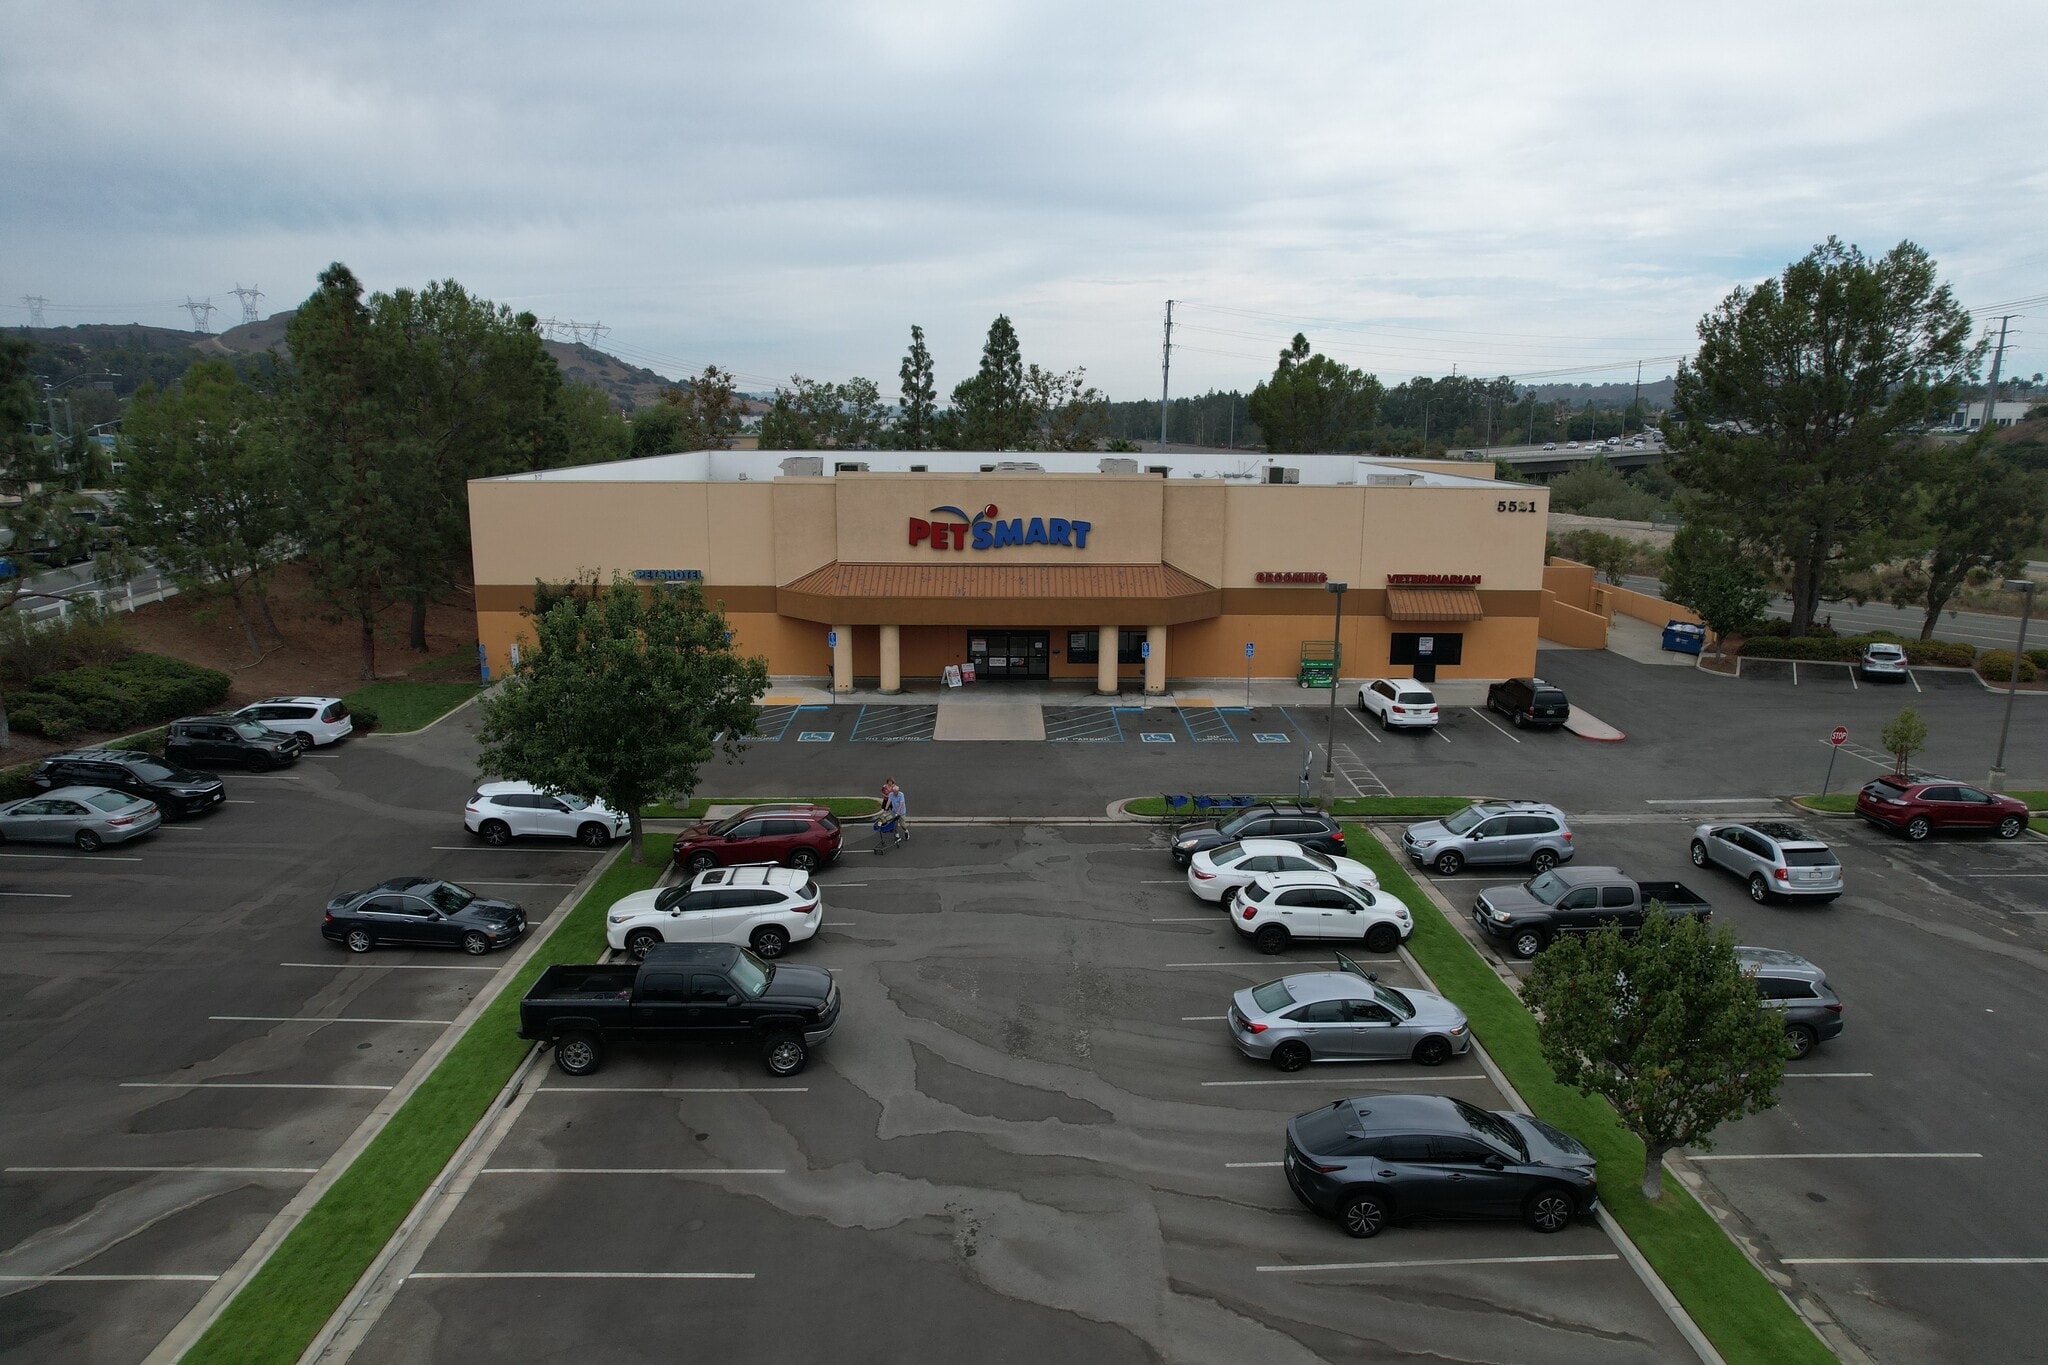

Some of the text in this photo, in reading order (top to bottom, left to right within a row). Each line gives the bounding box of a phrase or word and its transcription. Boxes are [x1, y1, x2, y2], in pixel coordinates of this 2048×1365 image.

[909, 516, 1091, 550] PETSMART
[635, 569, 703, 580] PETSHOTEL
[1255, 572, 1328, 583] GROOMING
[1387, 574, 1481, 584] VETERINARIAN
